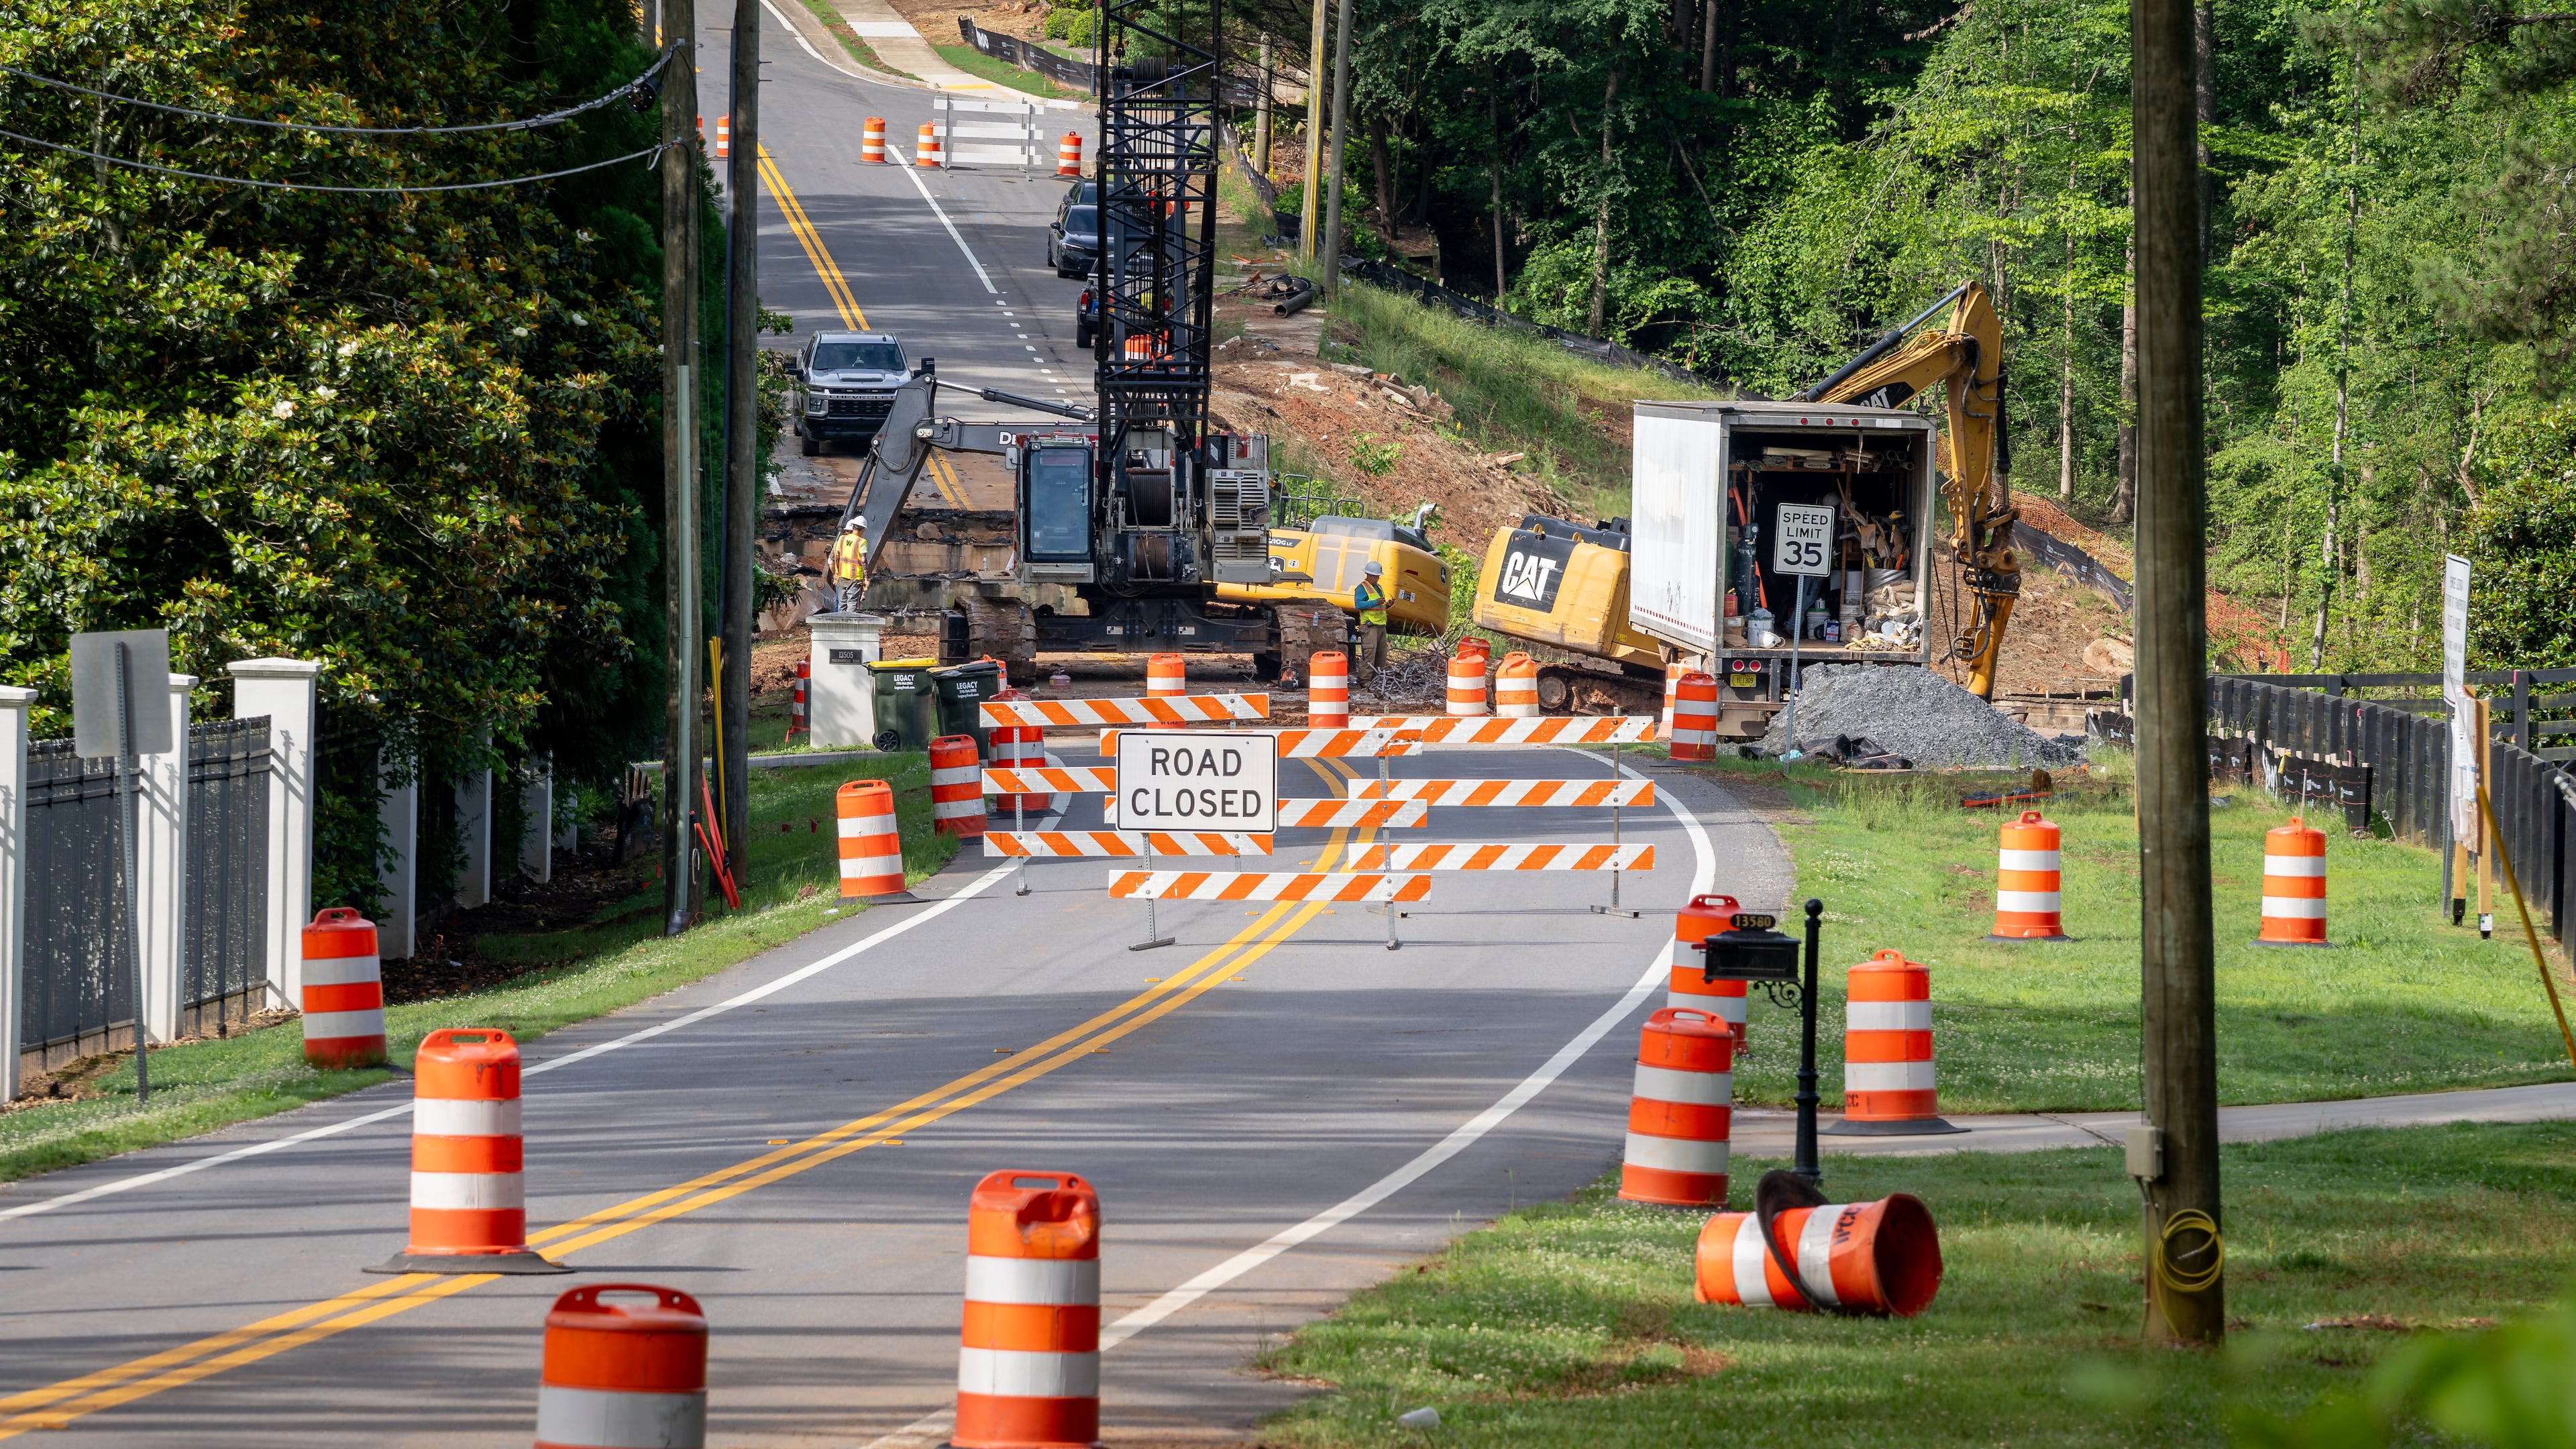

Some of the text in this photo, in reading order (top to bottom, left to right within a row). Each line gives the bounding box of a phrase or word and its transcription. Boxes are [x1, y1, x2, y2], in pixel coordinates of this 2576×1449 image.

[1783, 513, 1828, 525] SPEED
[1787, 527, 1822, 539] LIMIT
[1783, 541, 1822, 567] 35
[1502, 551, 1556, 601] CAT
[956, 681, 978, 690] LEGACY
[1151, 748, 1242, 776] ROAD
[1131, 788, 1261, 817] CLOSED
[1735, 915, 1772, 927] 13580
